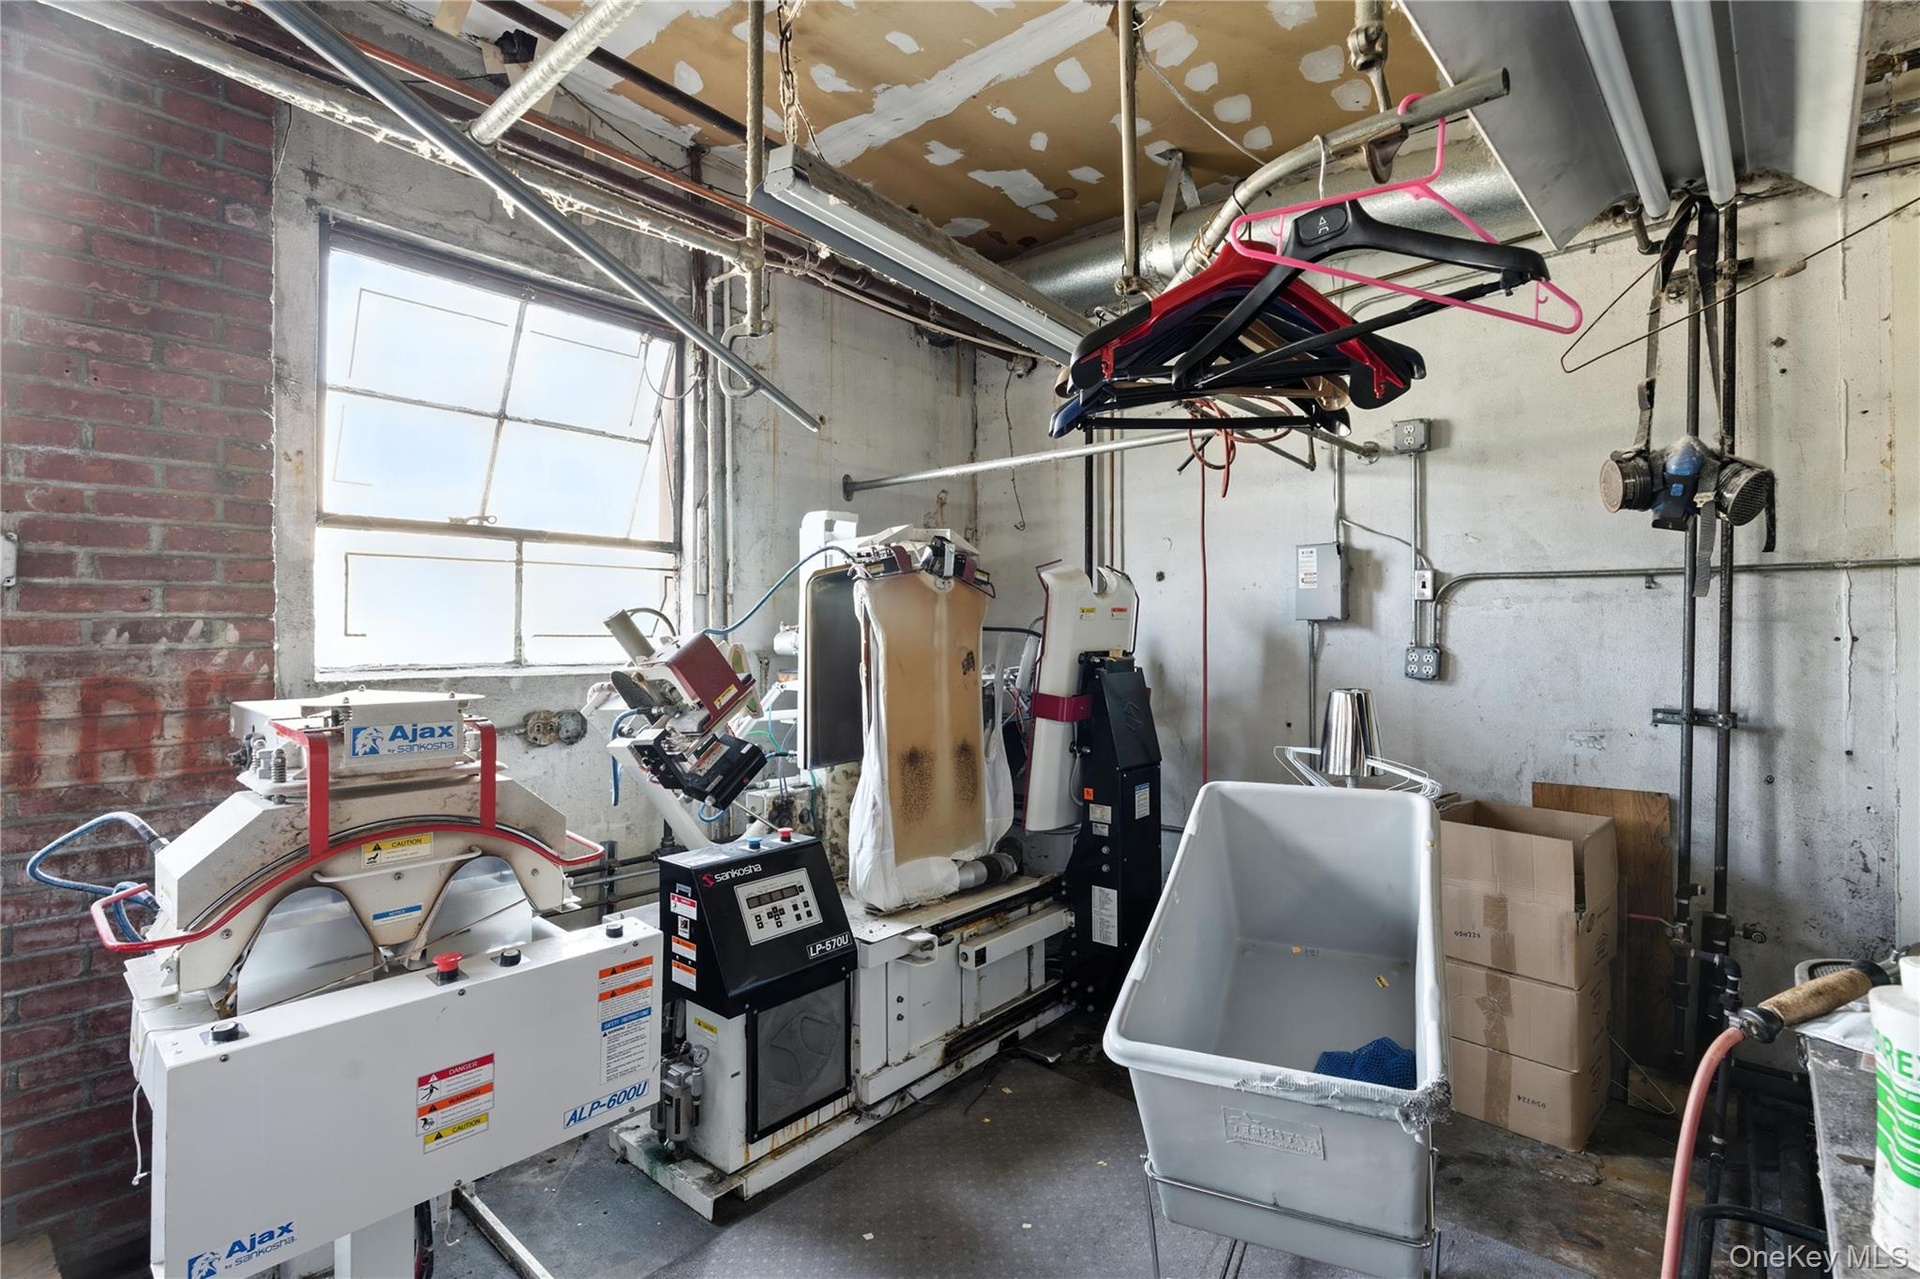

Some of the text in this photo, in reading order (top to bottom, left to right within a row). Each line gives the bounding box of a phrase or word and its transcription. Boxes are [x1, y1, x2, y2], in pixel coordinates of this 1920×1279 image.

[389, 724, 453, 743] Ajax
[392, 838, 422, 848] CAUTION
[809, 934, 849, 957] LP-570U
[449, 1061, 478, 1075] DANGER
[449, 1090, 480, 1104] WARNING
[566, 1081, 647, 1126] ALP-600U
[452, 1118, 480, 1133] CAUTION
[226, 1221, 293, 1259] Ajax
